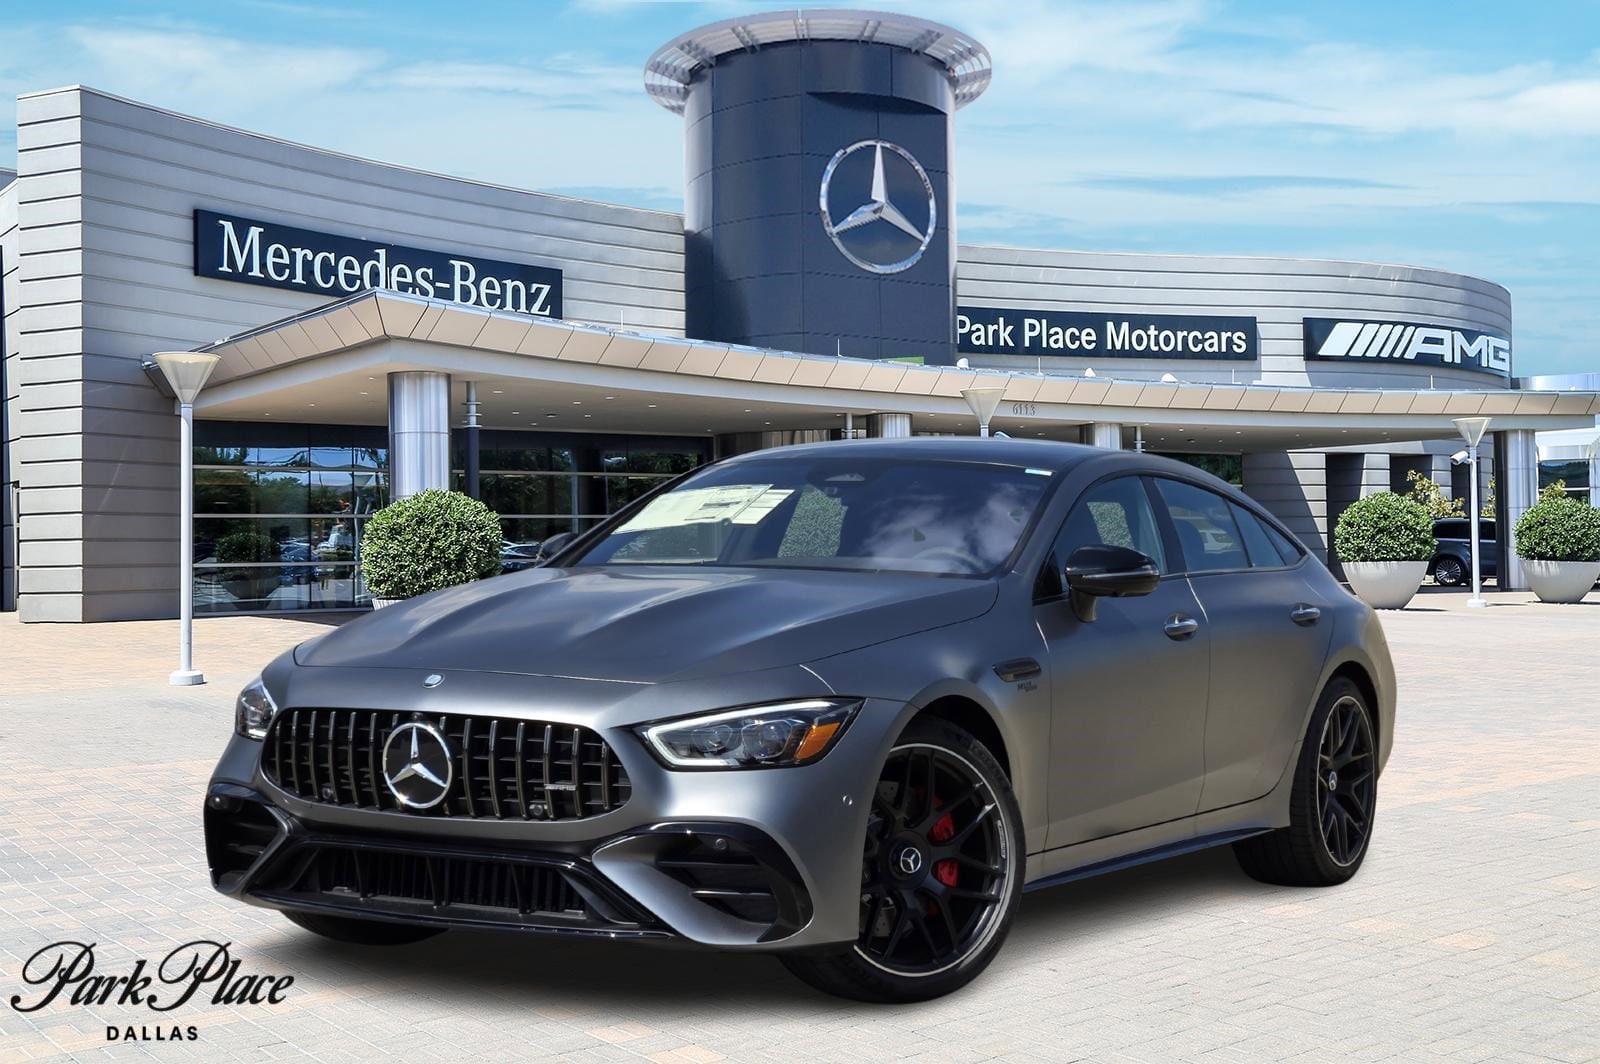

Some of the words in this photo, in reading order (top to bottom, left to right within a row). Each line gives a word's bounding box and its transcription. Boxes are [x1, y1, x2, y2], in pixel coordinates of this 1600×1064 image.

[217, 219, 553, 316] Mercedes-Benz
[957, 315, 1015, 347] Park
[1023, 317, 1097, 350] Place
[1106, 320, 1248, 354] Motorcars
[1012, 402, 1036, 416] 6113
